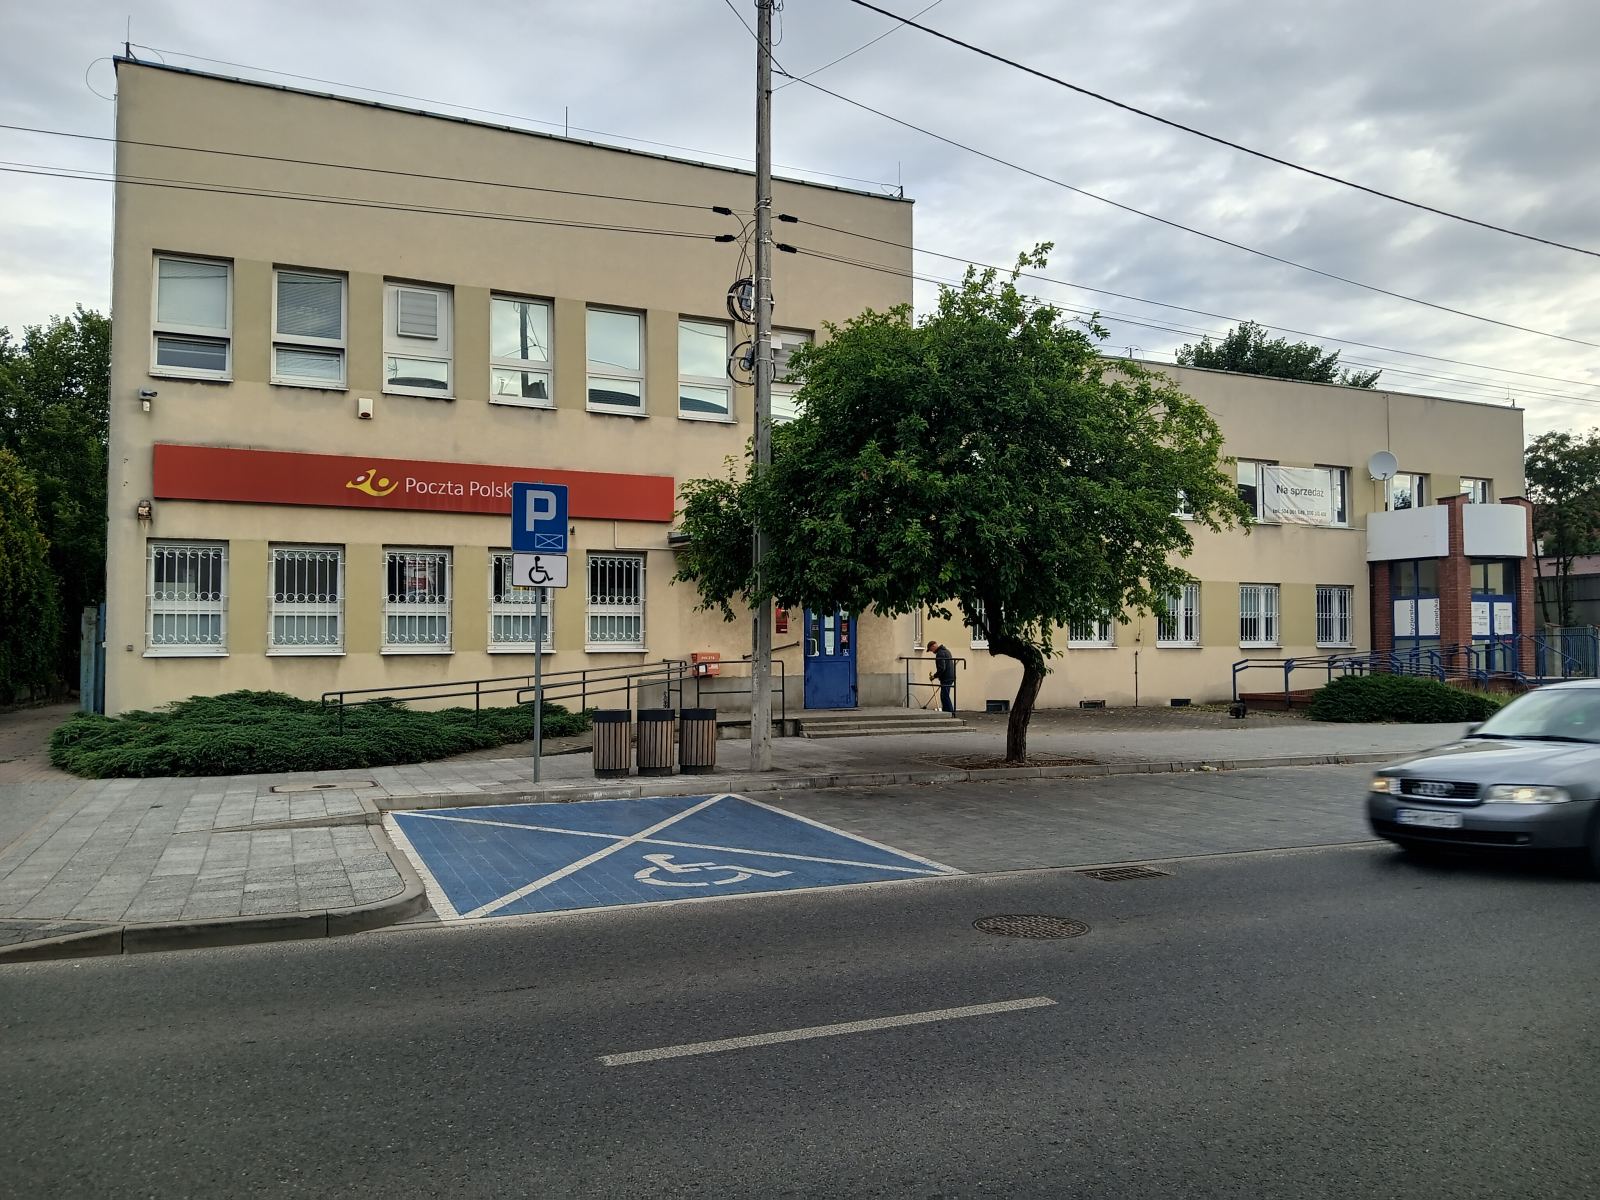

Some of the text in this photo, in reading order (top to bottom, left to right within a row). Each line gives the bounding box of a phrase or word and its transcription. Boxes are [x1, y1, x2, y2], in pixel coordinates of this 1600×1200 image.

[405, 477, 512, 498] Poczta Polsk
[1276, 484, 1289, 495] Na
[526, 490, 557, 532] P
